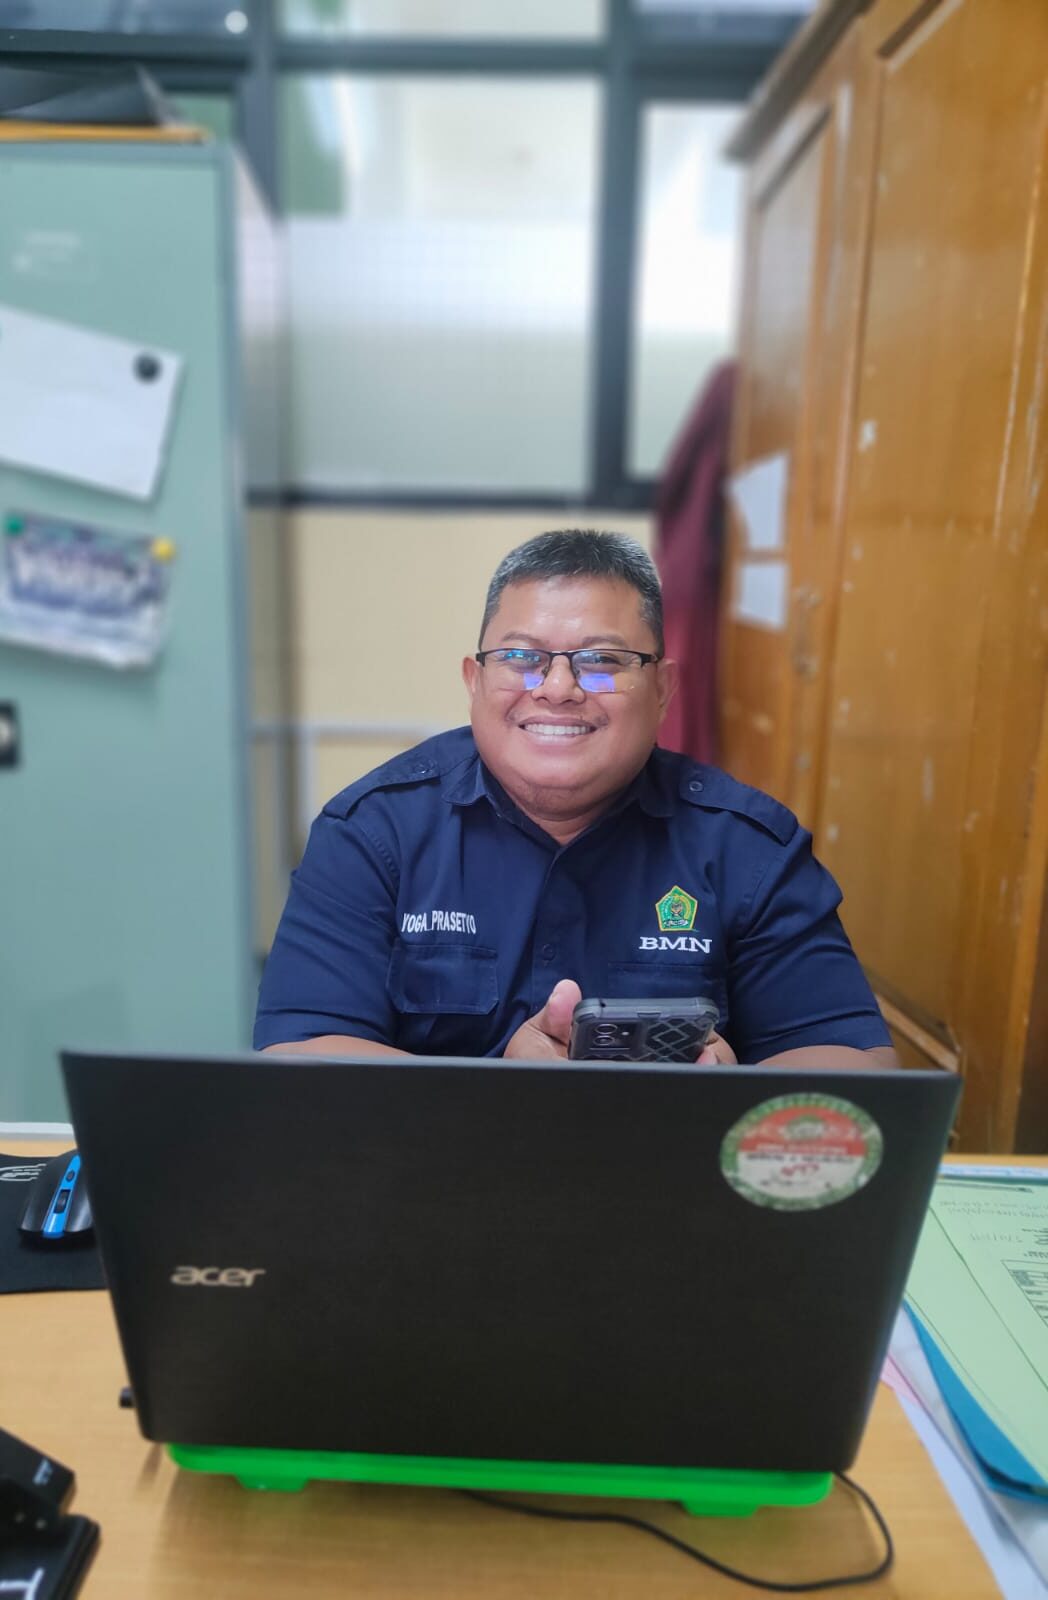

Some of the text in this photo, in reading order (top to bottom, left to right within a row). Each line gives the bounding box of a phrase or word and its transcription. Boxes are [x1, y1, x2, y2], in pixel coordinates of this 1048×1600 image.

[401, 912, 428, 934] YOGA
[638, 936, 713, 954] BMN
[170, 1265, 267, 1288] acer
